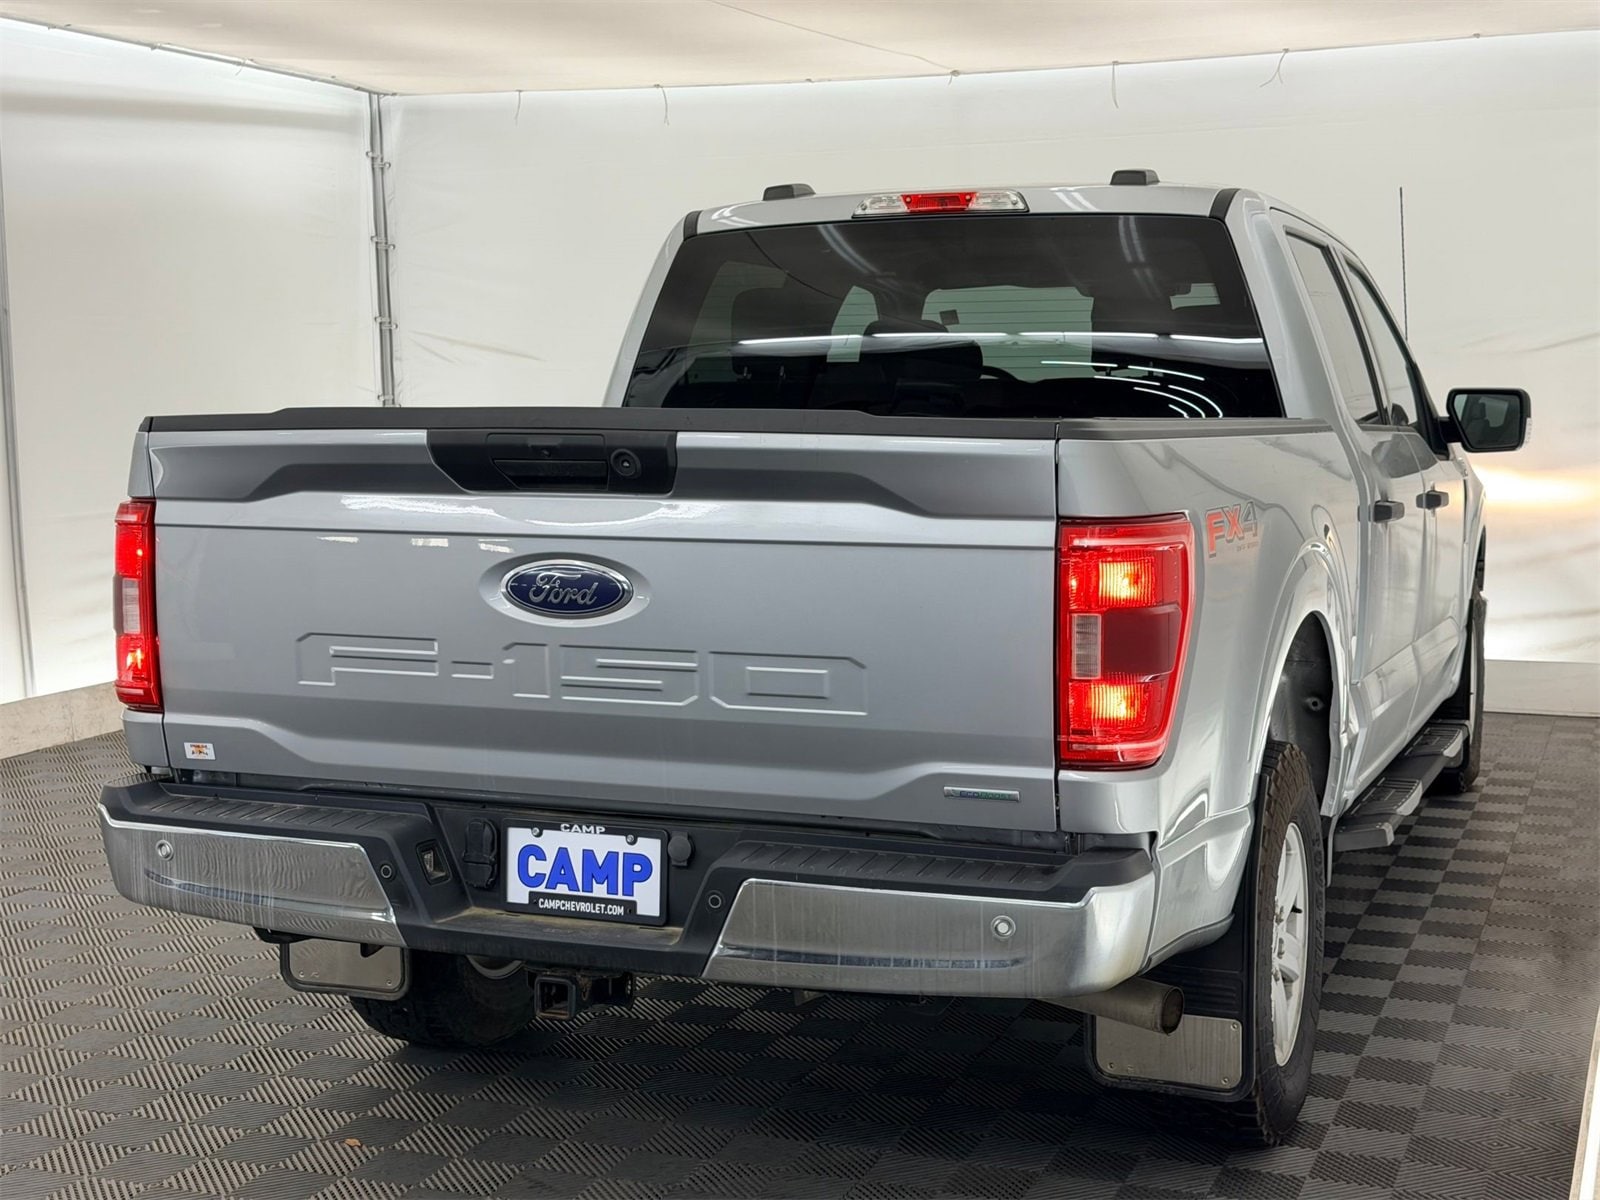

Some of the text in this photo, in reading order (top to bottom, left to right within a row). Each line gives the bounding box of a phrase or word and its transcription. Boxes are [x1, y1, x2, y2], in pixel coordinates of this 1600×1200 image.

[1205, 501, 1258, 559] FX4
[528, 571, 599, 606] Ford
[296, 632, 868, 716] F-150
[560, 823, 606, 834] CAMP
[517, 843, 653, 897] CAMP
[538, 897, 625, 916] CAMPCHEVROLET.COM
